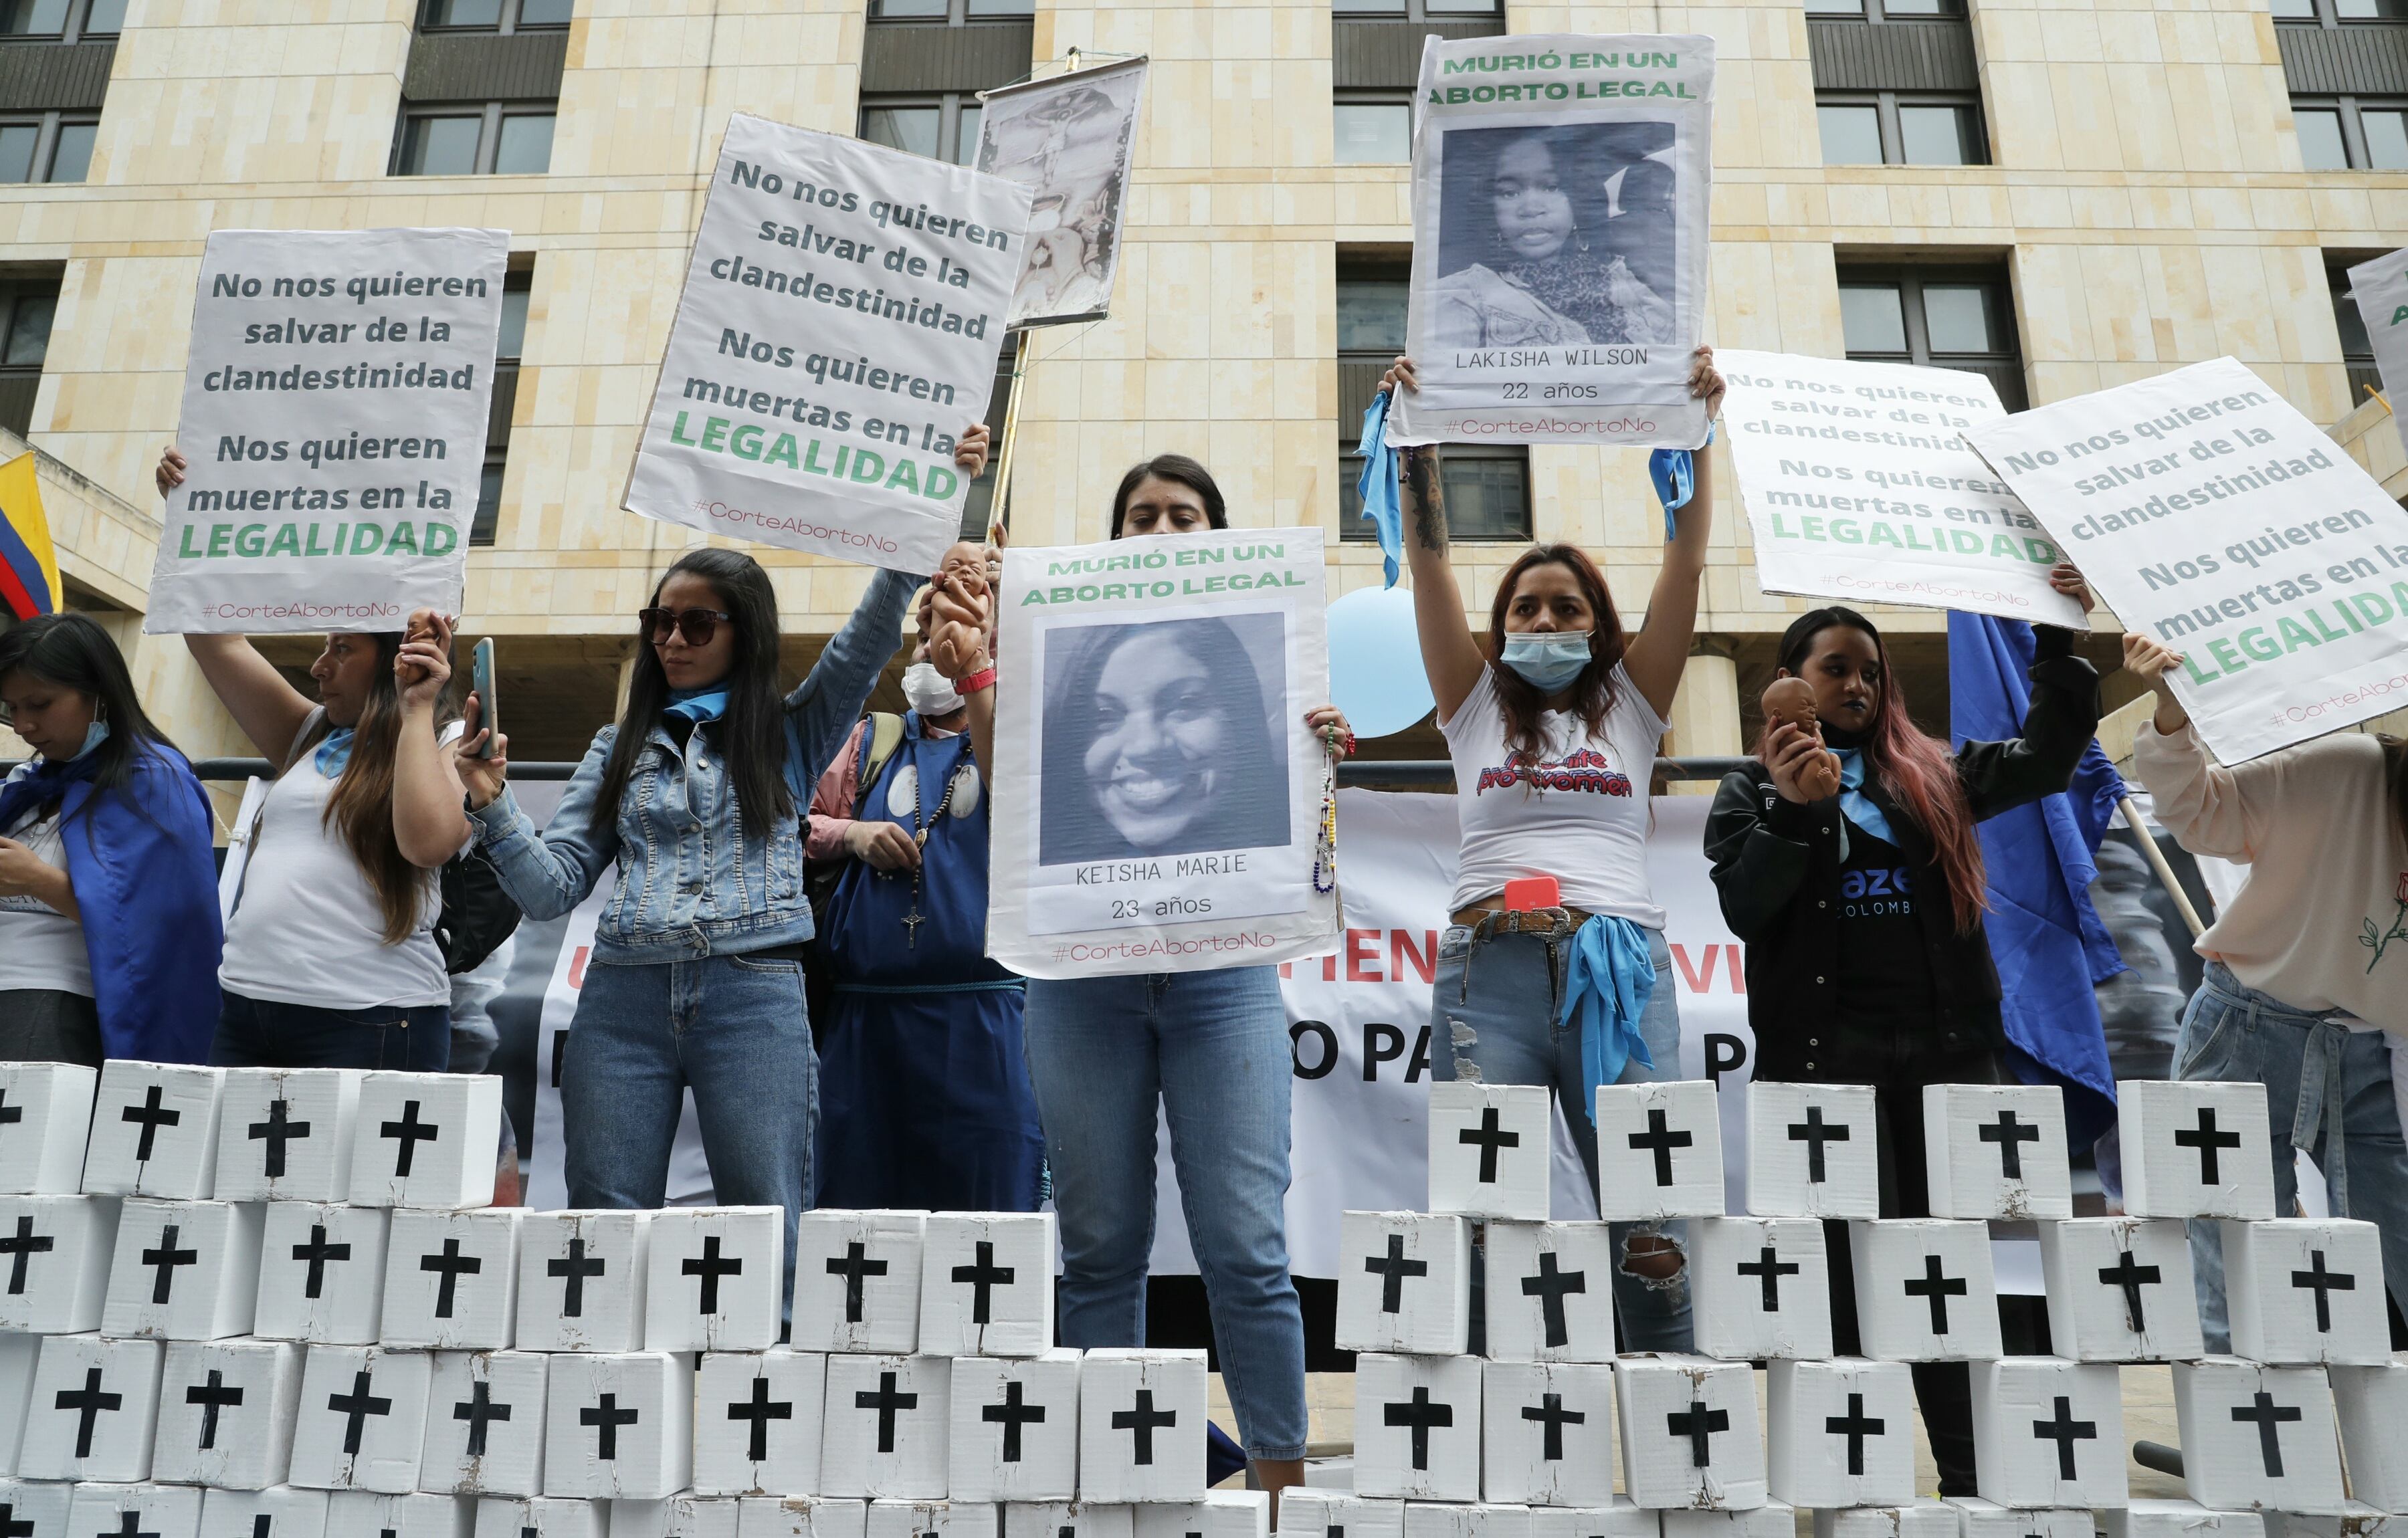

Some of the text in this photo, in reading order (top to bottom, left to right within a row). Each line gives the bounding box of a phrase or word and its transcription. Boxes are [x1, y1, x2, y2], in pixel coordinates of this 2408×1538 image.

[1444, 49, 1678, 74] MURIÓ EN UN
[1428, 80, 1697, 105] ABORTO LEGAL
[730, 160, 1008, 252] No nos quieren
[758, 221, 970, 289] salvar de la
[212, 271, 487, 306] No nos quieren
[710, 255, 988, 340] clandestinidad
[244, 316, 451, 344] salvar de la
[718, 328, 955, 406] Nos quieren
[1456, 348, 1647, 369] LAKISHA WILSON
[203, 362, 474, 392] clandestinidad
[1502, 382, 1598, 399] 22 años
[1726, 373, 1987, 409] No nos quieren
[682, 377, 955, 457] muertas en la
[1444, 417, 1656, 435] #CorteAbortoNo
[1771, 400, 1971, 428] salvar de la
[217, 431, 446, 469] Nos quieren
[1743, 419, 1965, 452] clandestinid
[2003, 391, 2268, 475] No nos quieren
[670, 411, 958, 500] LEGALIDAD
[2074, 423, 2276, 496] salvar de la
[1779, 459, 2015, 496] Nos quieren
[187, 480, 452, 512] muertas en la
[1766, 490, 2038, 530] muertas en la
[2071, 447, 2334, 546] clandestinidad
[178, 521, 458, 558] LEGALIDAD
[692, 502, 898, 553] #CorteAbortoNo
[1771, 513, 2058, 565] LEGALIDAD
[1048, 544, 1284, 576] MURIÓ EN UN
[2137, 509, 2374, 591] Nos quieren
[1020, 570, 1306, 607] ABORTO LEGAL
[1819, 573, 2030, 607] #CorteAbortoNo
[2153, 573, 2322, 641] muertas
[2326, 557, 2380, 584] en
[202, 599, 400, 619] #CorteAbortoNo
[1076, 854, 1247, 885] KEISHA MARIE
[1111, 896, 1212, 919] 23 años
[1052, 930, 1276, 962] #CorteAbortoNo
